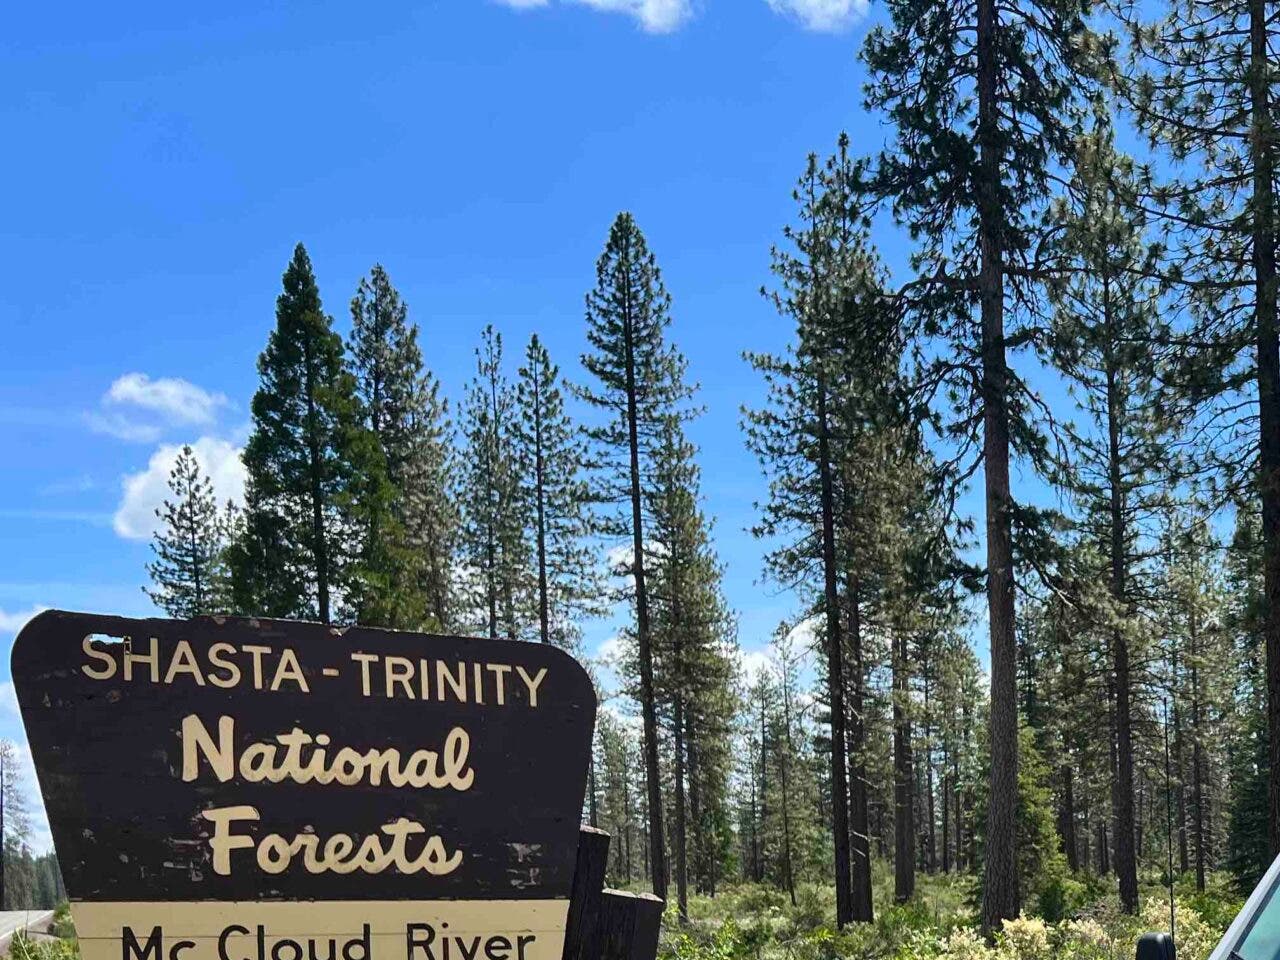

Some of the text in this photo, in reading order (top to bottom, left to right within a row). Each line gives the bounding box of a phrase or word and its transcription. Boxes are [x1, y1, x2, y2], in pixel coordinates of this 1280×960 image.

[82, 633, 310, 693] SHASTA
[350, 652, 548, 708] TRINITY
[181, 714, 475, 792] National
[202, 804, 463, 876] Forests
